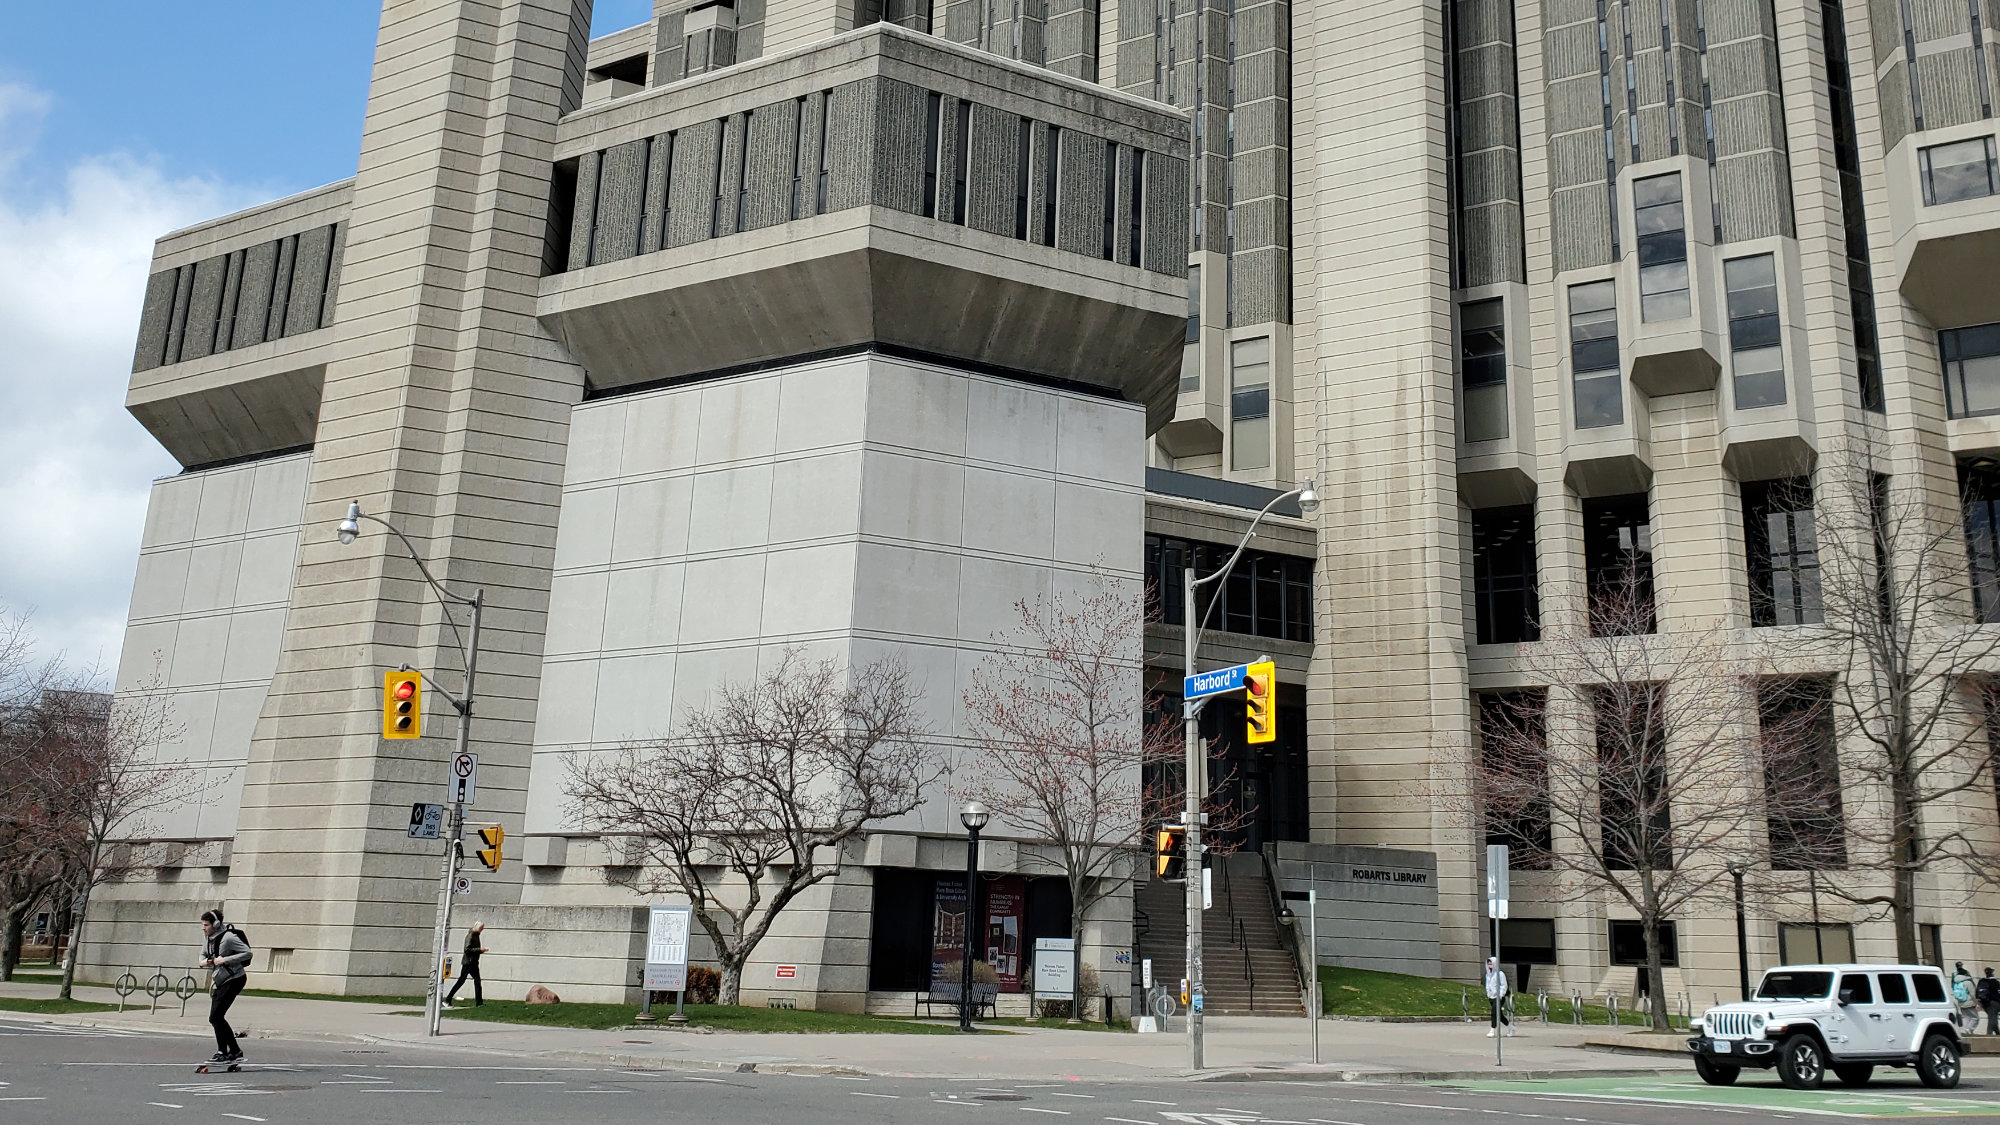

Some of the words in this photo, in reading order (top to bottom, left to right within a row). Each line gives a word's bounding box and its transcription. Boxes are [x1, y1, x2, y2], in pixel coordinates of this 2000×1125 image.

[1193, 671, 1230, 693] Harbord
[1231, 669, 1238, 679] St
[1352, 868, 1391, 881] ROBARTS
[1393, 872, 1427, 884] LIBRARY
